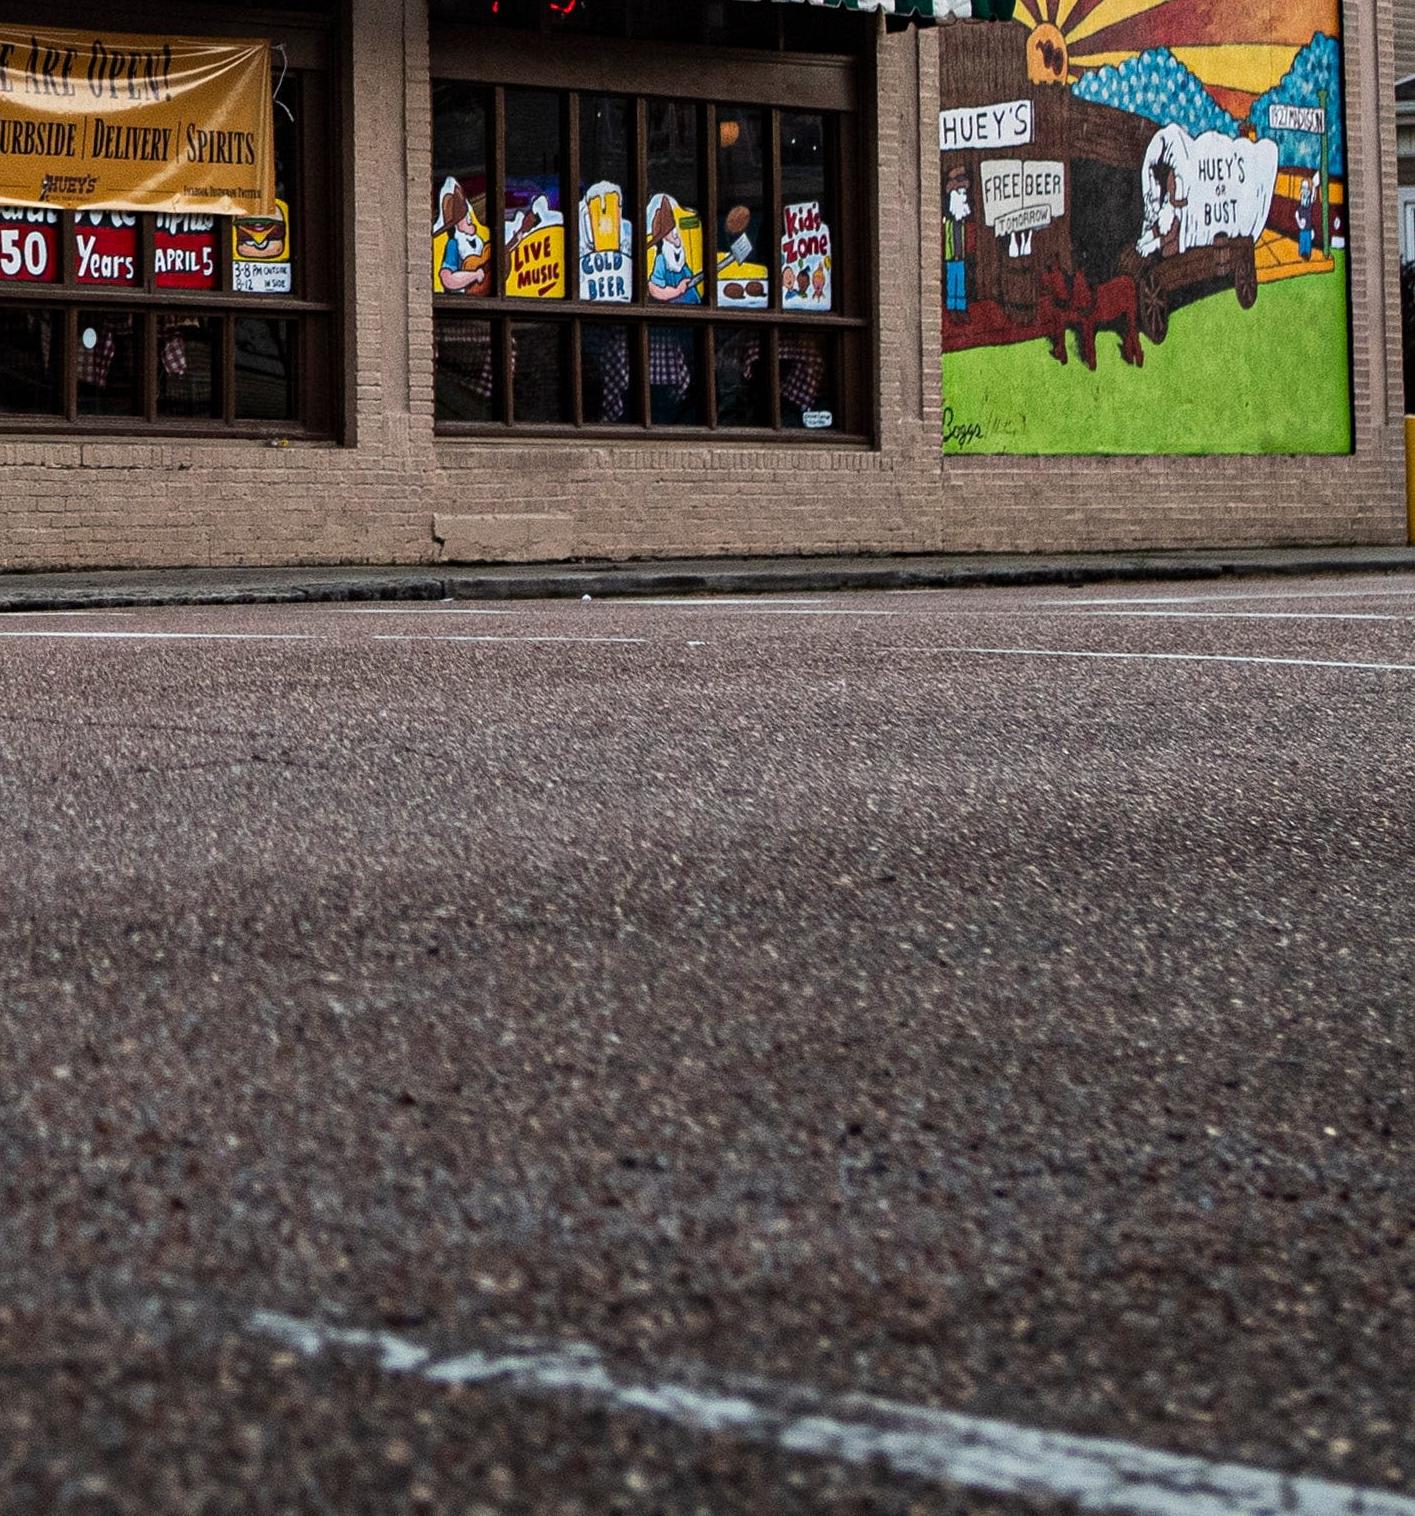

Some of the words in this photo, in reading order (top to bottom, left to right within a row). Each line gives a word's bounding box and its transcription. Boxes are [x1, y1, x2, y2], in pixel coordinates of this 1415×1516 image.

[25, 35, 79, 97] ARE
[87, 39, 172, 102] OPEN!
[943, 103, 1028, 145] HUEY'S
[91, 117, 173, 162] DELIVERY
[185, 122, 256, 166] SPIRITS
[1198, 152, 1246, 184] HUEY'S
[45, 173, 99, 194] HUEY'S
[984, 173, 1021, 203] FREE
[1025, 173, 1061, 196] BEER
[998, 208, 1049, 232] TOMORROW
[1204, 199, 1238, 226] BUST
[0, 228, 48, 276] 50
[76, 234, 134, 279] Years
[154, 249, 200, 273] APRIL
[202, 246, 214, 276] 5
[514, 235, 551, 272] LIVE
[581, 252, 623, 275] COLD
[517, 262, 560, 290] MUSIC
[587, 277, 625, 300] BEER
